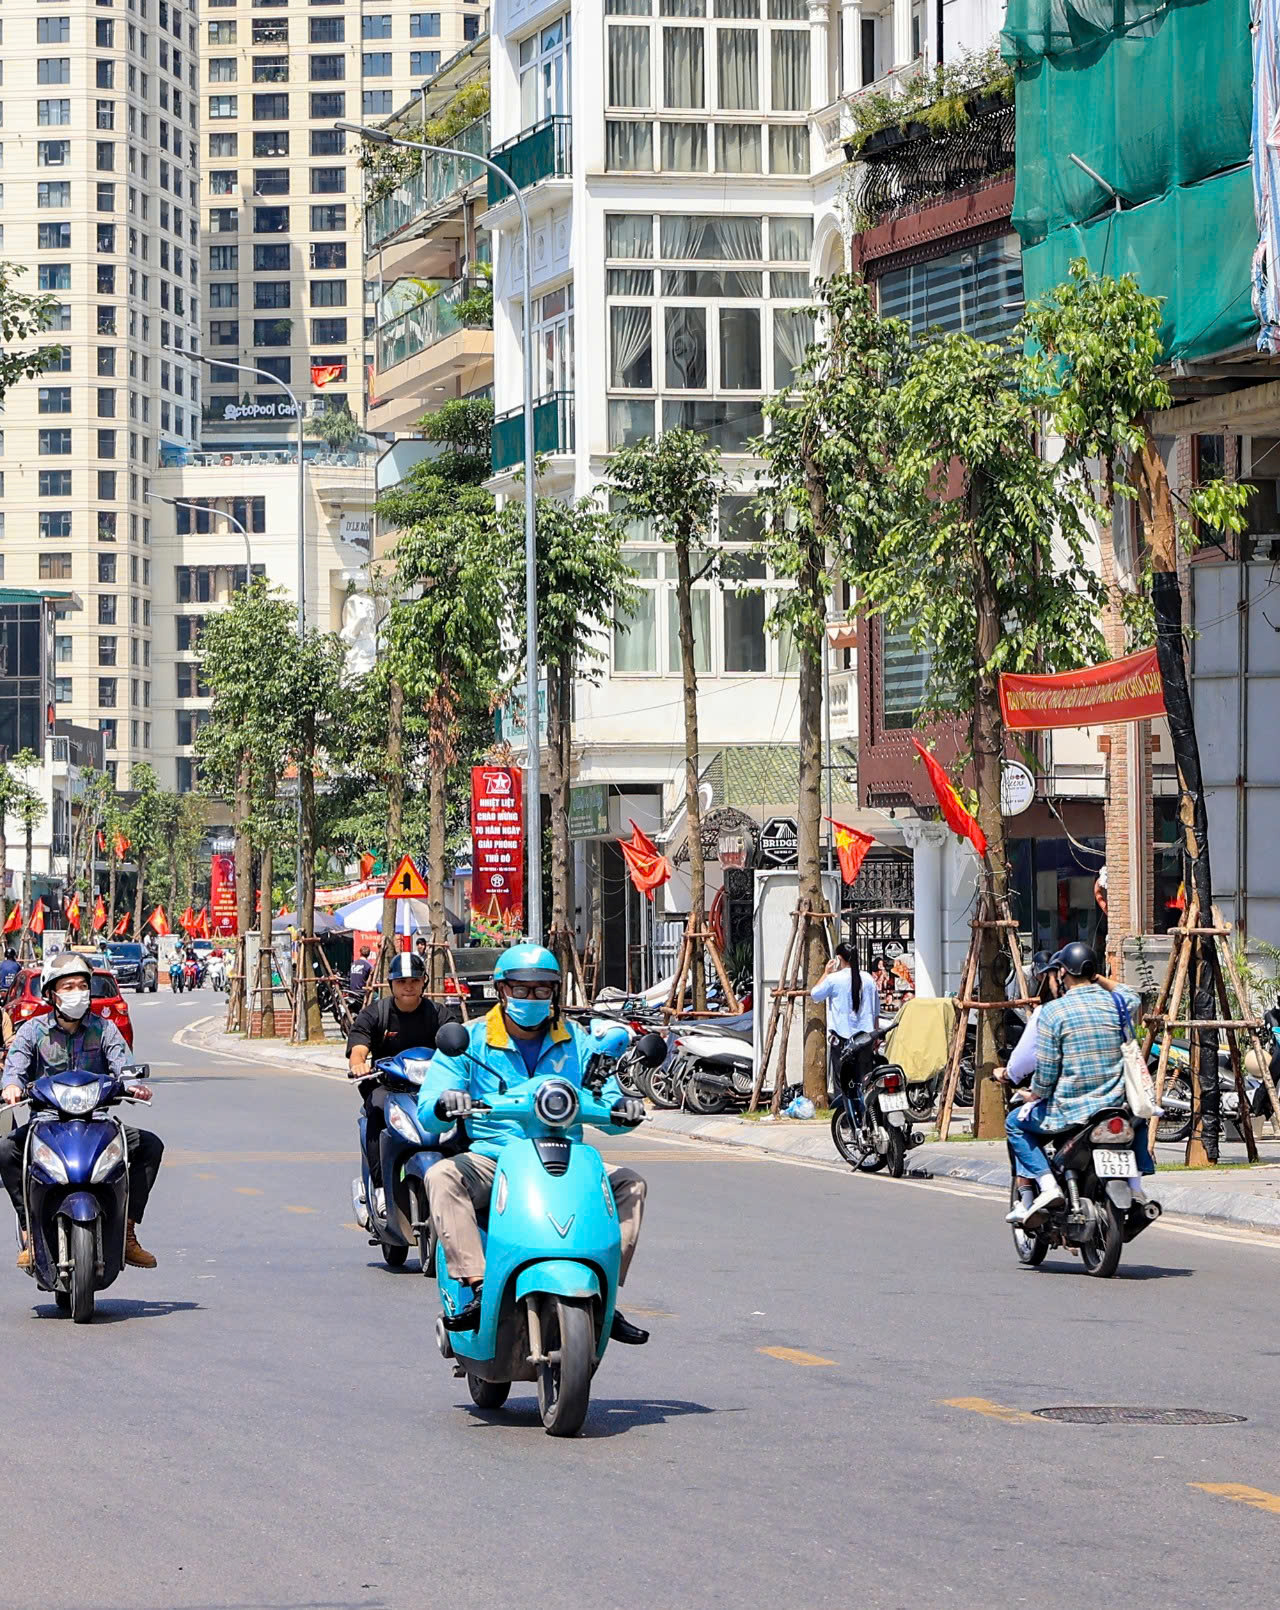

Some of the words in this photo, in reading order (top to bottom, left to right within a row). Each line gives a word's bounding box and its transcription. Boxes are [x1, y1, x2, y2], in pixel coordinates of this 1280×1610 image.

[278, 403, 302, 416] Caf
[475, 826, 484, 835] 70
[763, 839, 798, 848] BRIDGE
[1102, 1164, 1130, 1175] 2627
